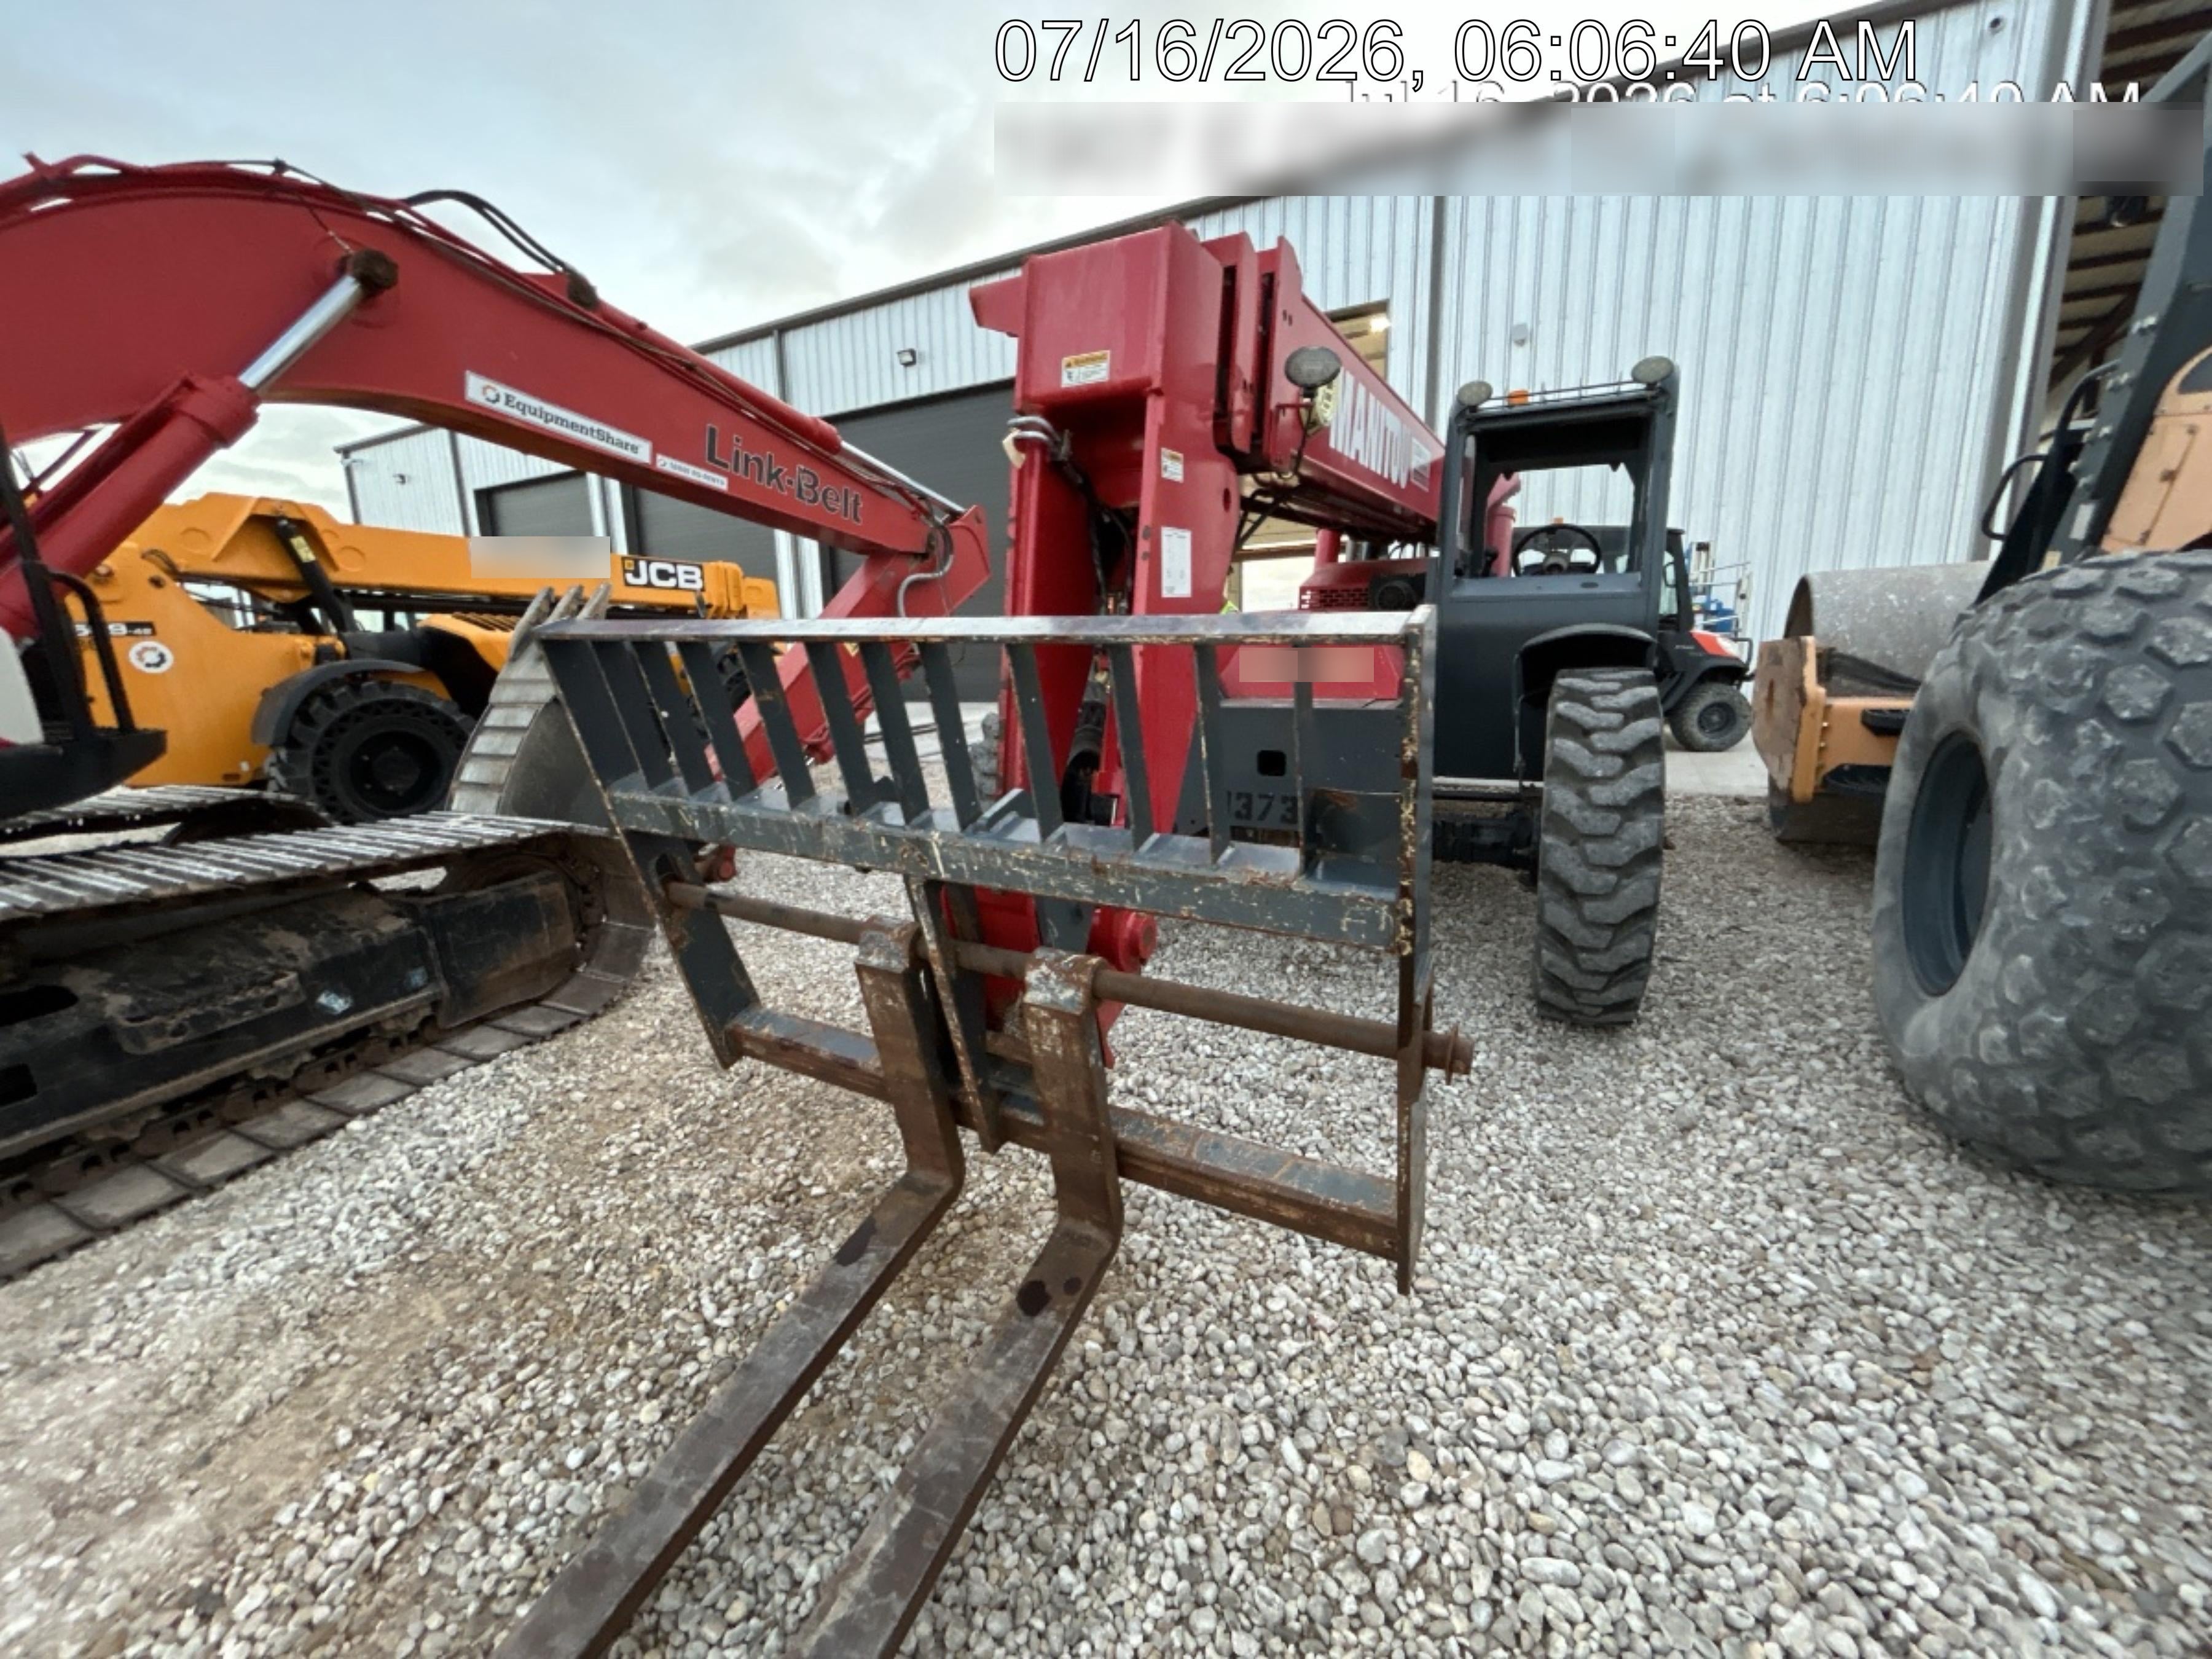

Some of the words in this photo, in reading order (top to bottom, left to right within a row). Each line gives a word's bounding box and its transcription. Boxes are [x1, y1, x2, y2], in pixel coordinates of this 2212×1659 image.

[504, 392, 639, 454] EquipmentShare
[1329, 366, 1411, 489] MANITOU
[706, 424, 863, 526] Link-Belt
[624, 560, 704, 590] JCB
